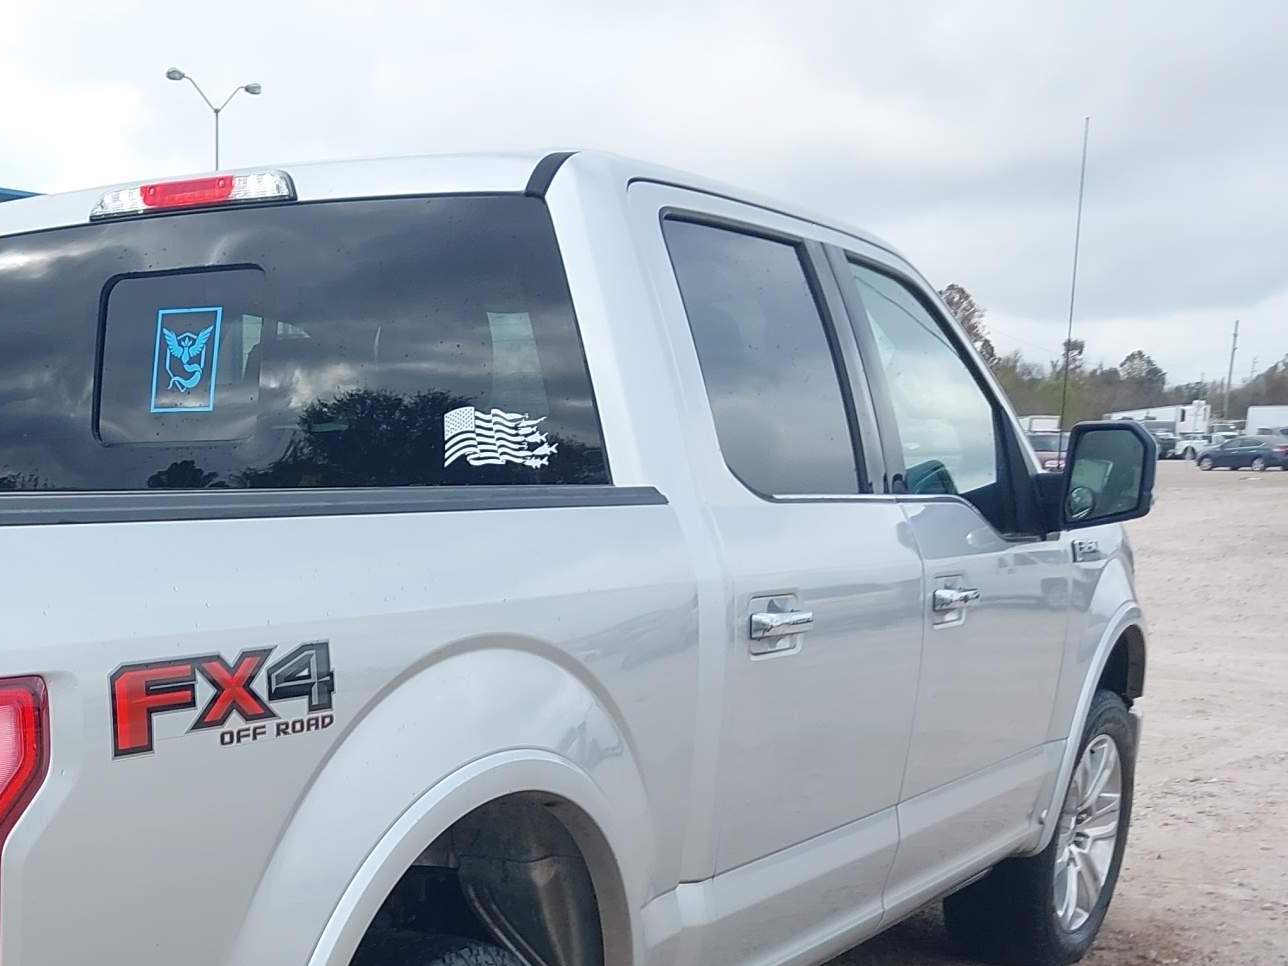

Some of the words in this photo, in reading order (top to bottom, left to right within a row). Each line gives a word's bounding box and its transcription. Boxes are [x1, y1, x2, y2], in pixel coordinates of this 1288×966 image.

[110, 640, 334, 758] FX4
[220, 725, 267, 746] OFF
[276, 714, 334, 737] ROAD
